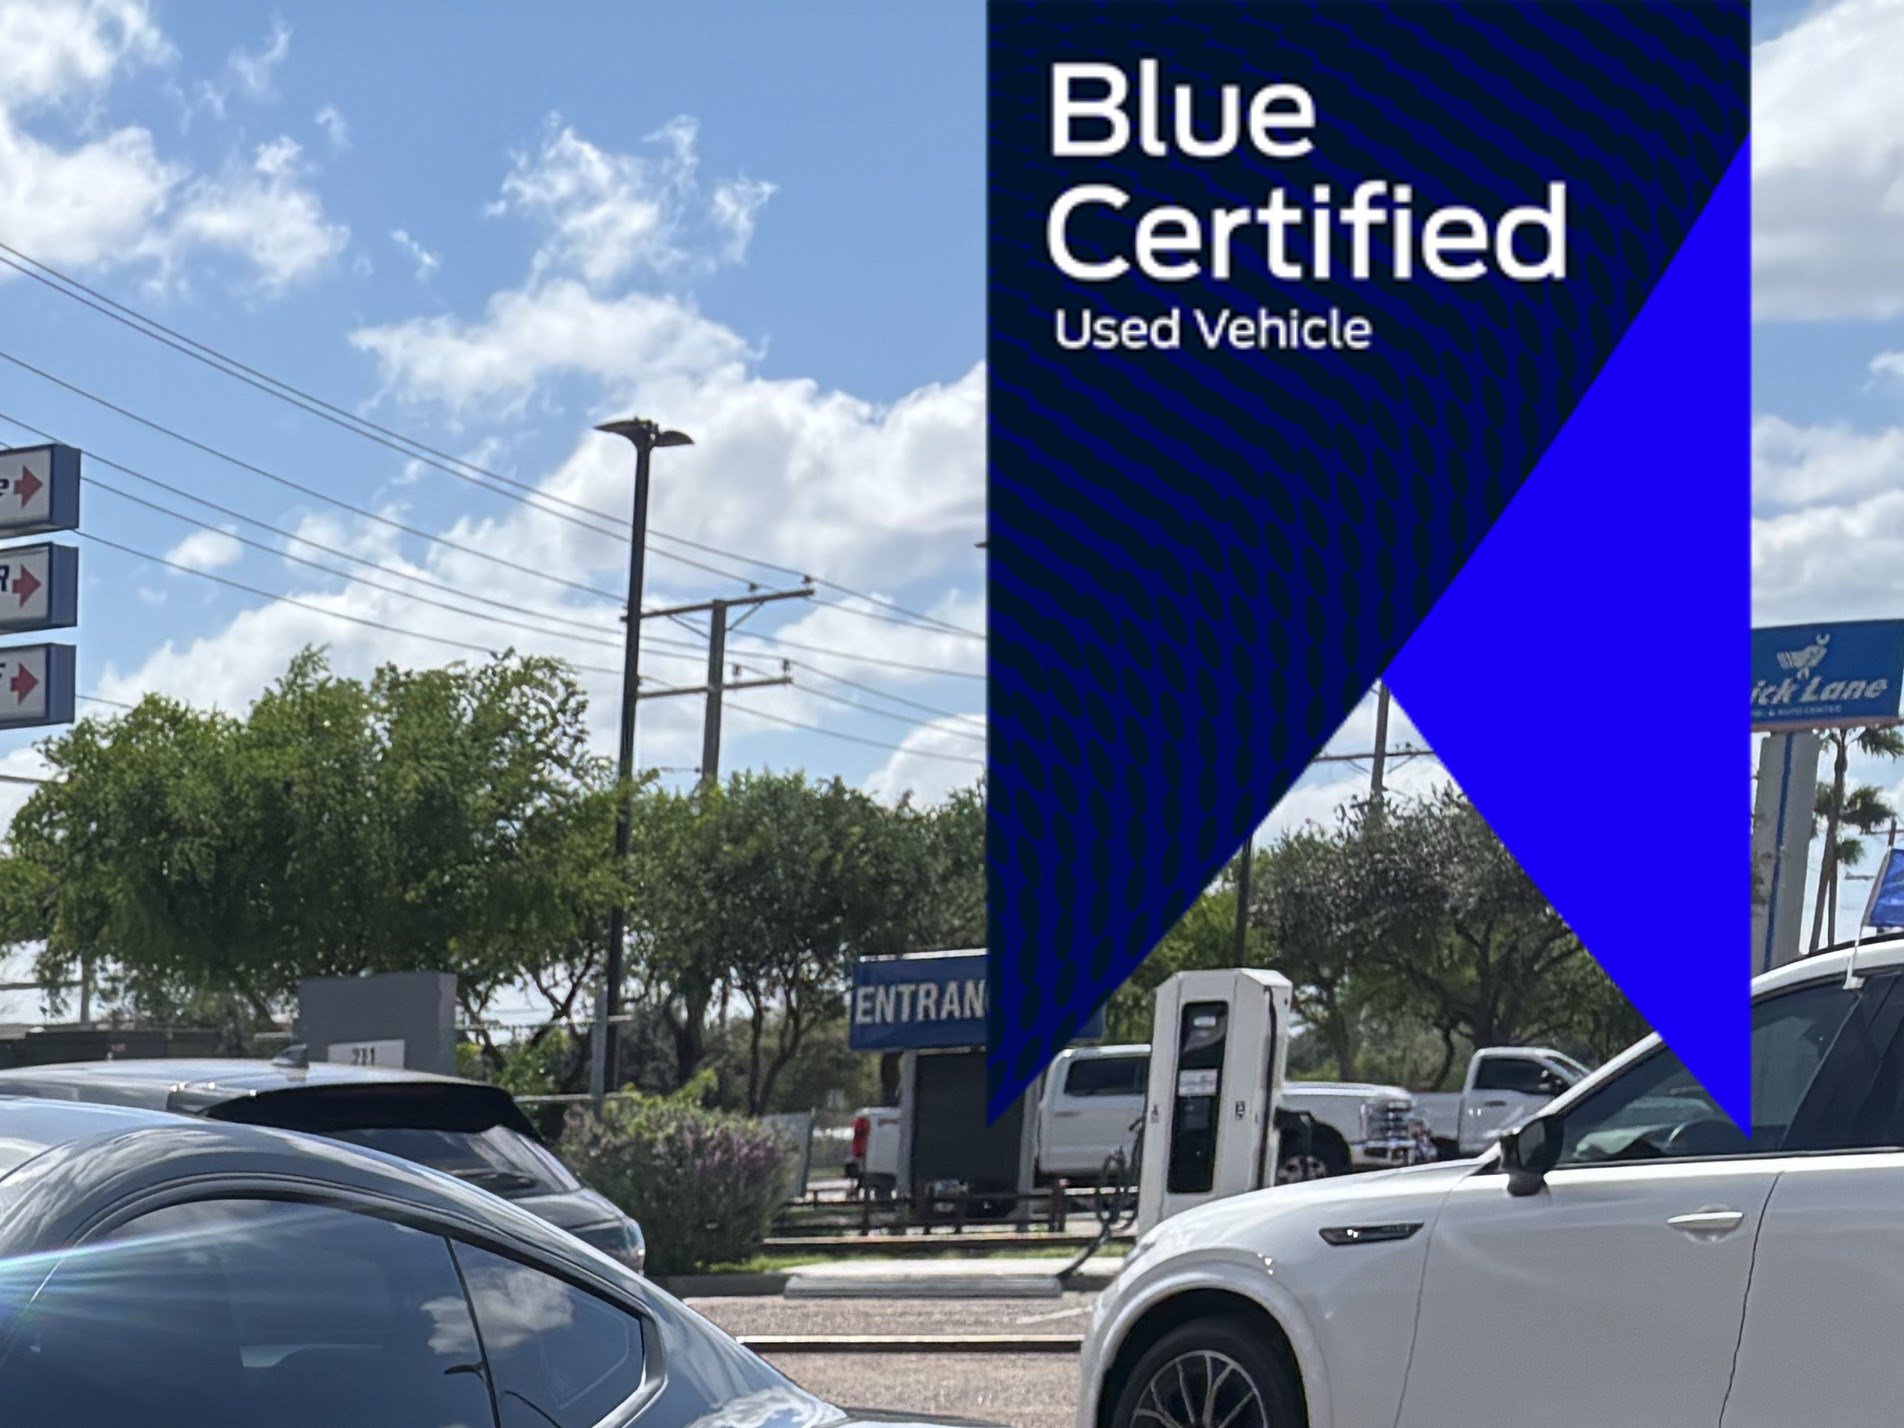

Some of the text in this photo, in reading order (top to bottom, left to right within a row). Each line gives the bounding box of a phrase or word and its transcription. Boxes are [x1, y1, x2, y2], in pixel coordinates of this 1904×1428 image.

[1751, 675, 1889, 705] ick Lane
[855, 979, 989, 1025] ENTRAN
